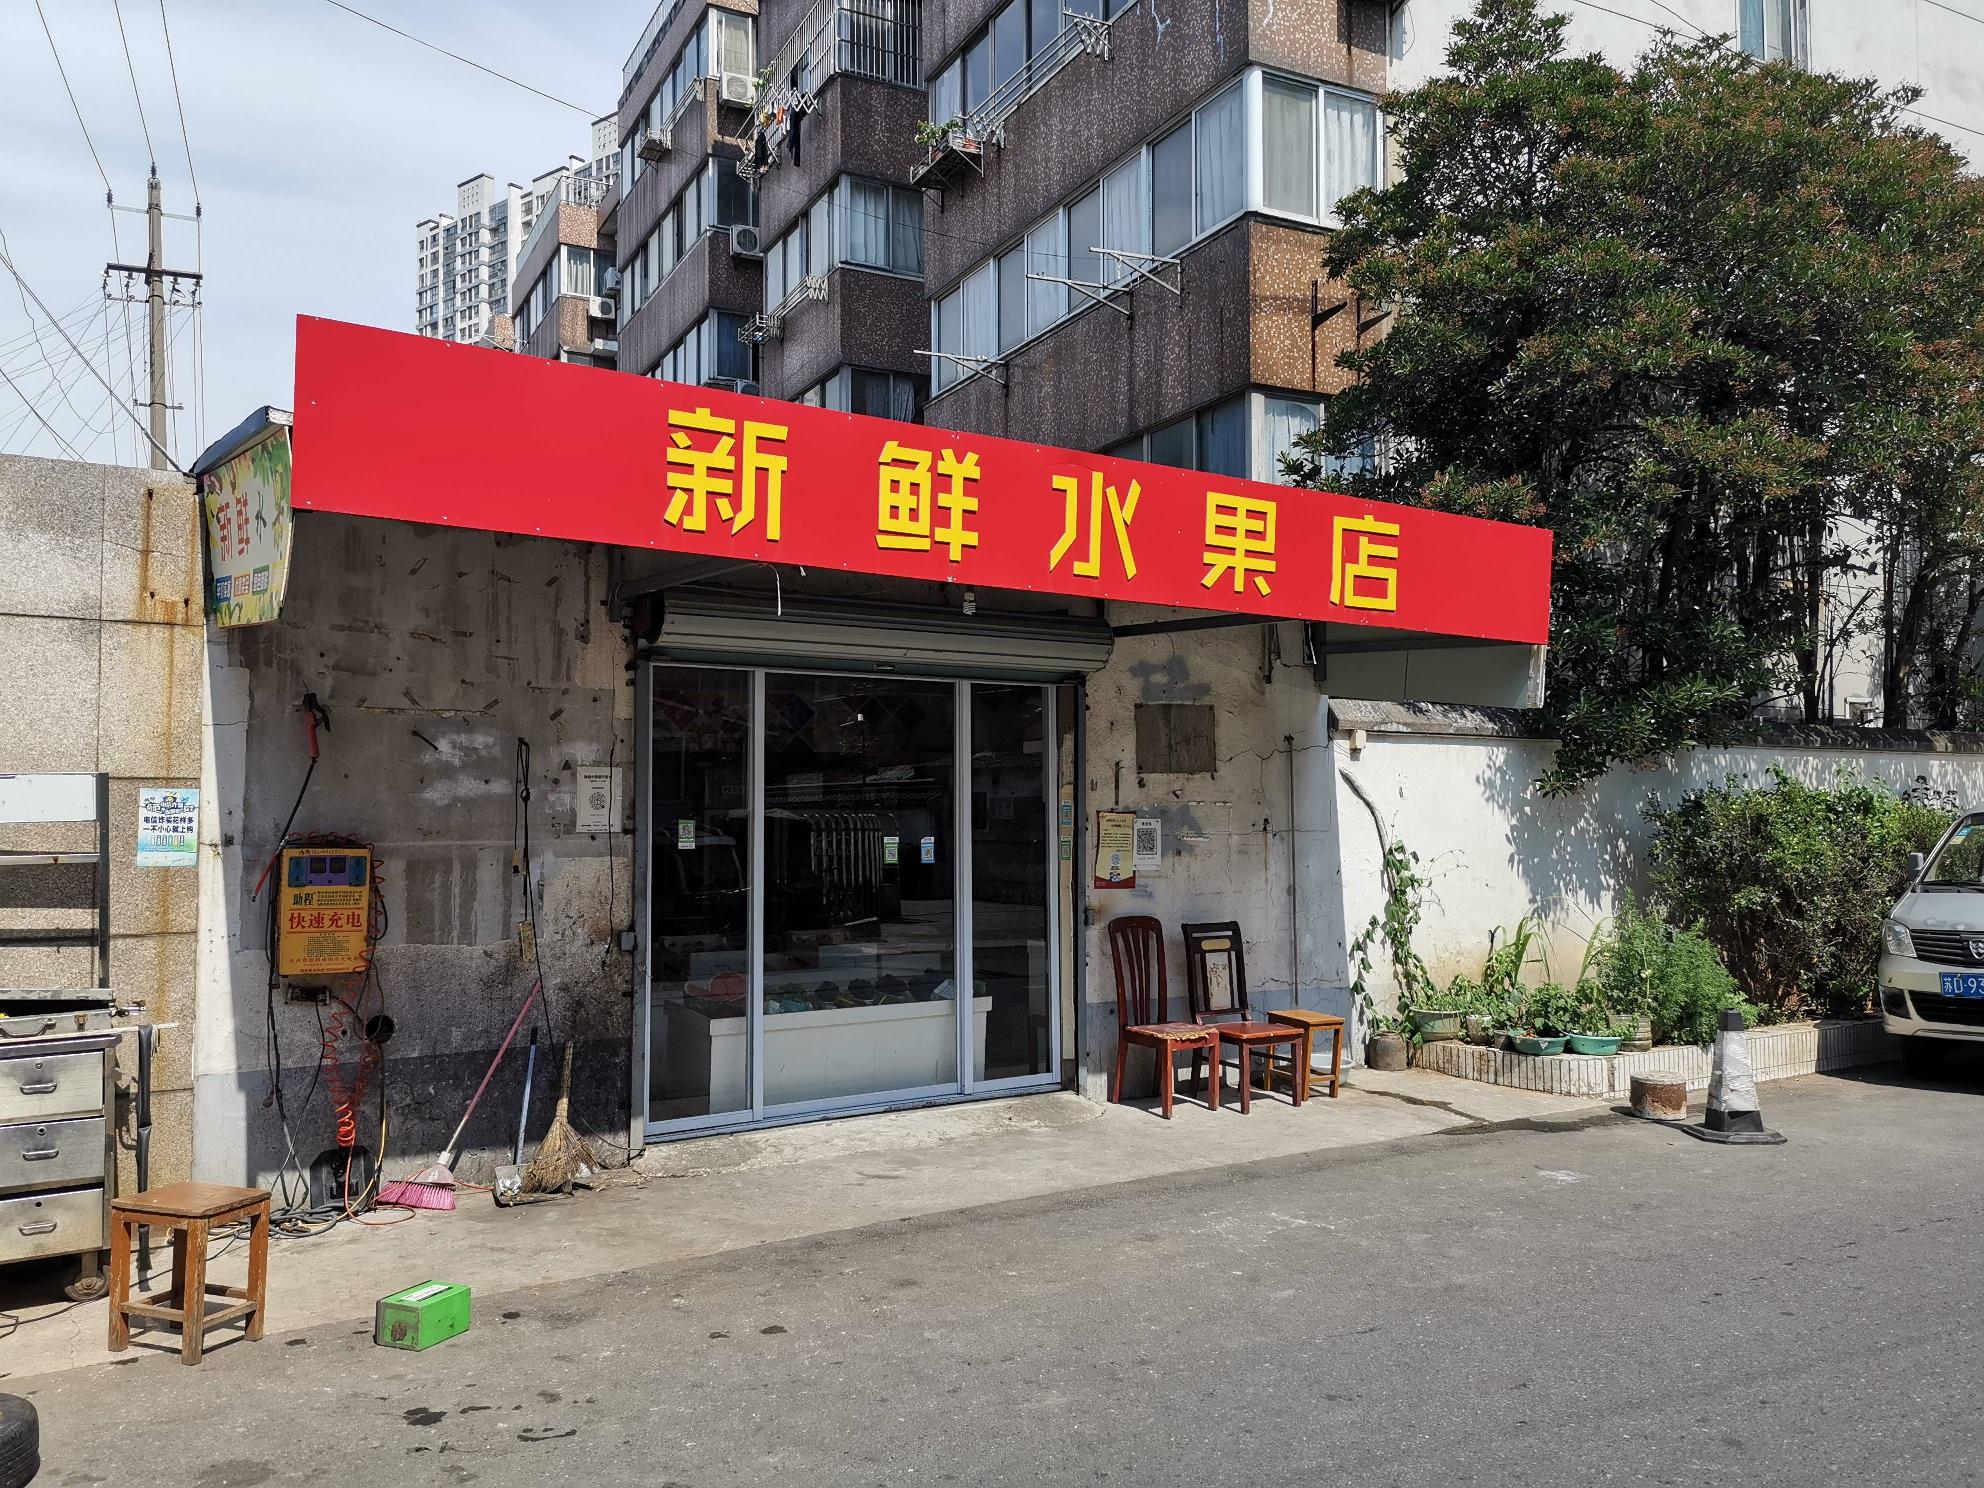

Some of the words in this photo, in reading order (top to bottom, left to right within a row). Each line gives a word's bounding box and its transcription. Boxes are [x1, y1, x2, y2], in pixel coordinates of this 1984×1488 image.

[663, 406, 1401, 612] 新鲜水果店
[288, 910, 363, 930] 快速充电
